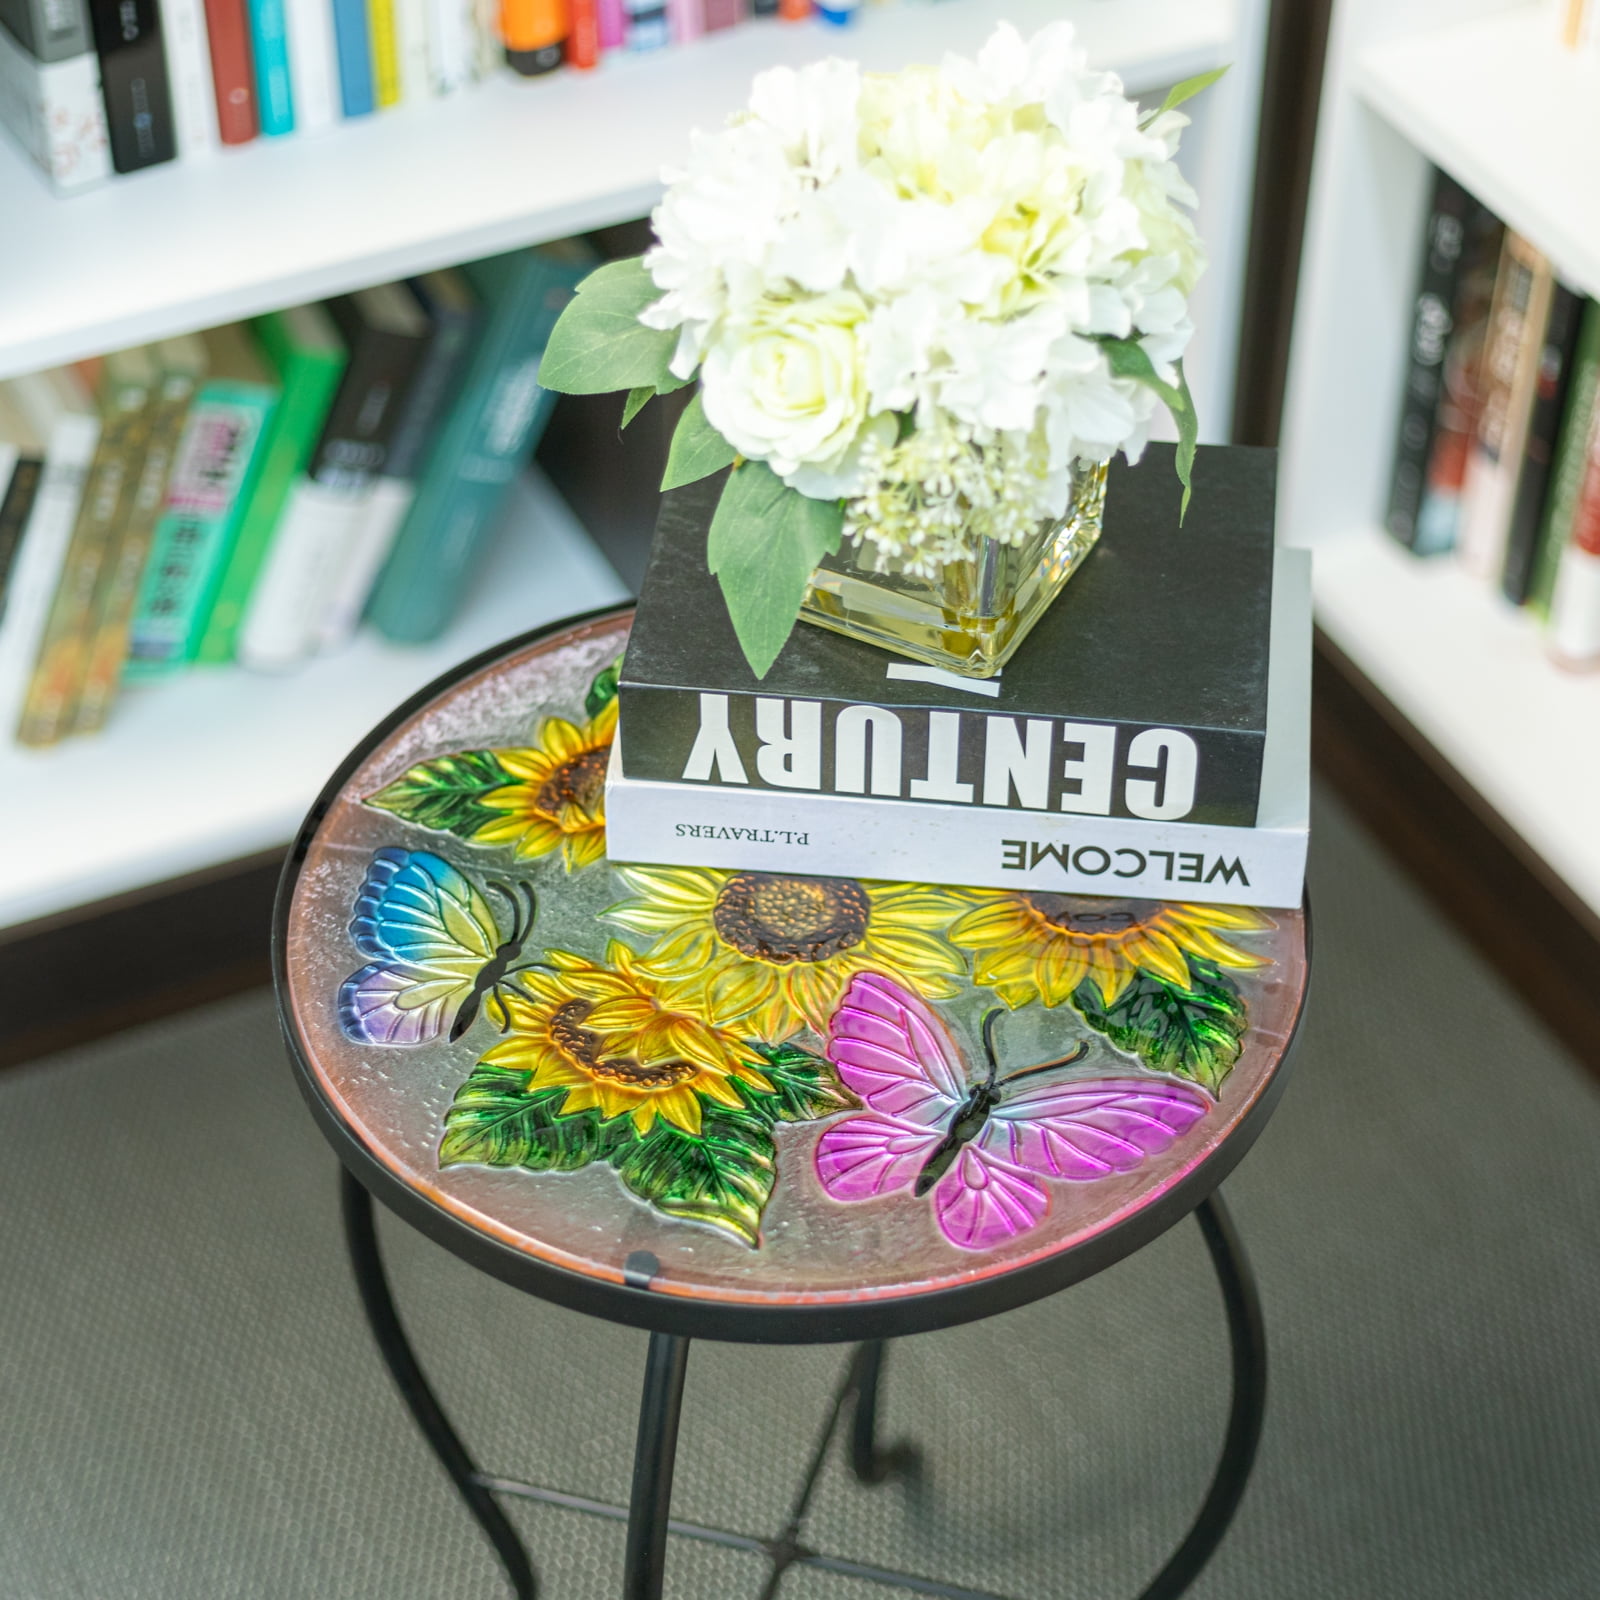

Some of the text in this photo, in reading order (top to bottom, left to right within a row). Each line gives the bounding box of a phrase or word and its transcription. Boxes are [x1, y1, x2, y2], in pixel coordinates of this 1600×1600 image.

[682, 692, 1199, 821] CENTURY
[675, 823, 809, 845] P.L.TRAVERS
[1001, 839, 1251, 887] WELCOME
